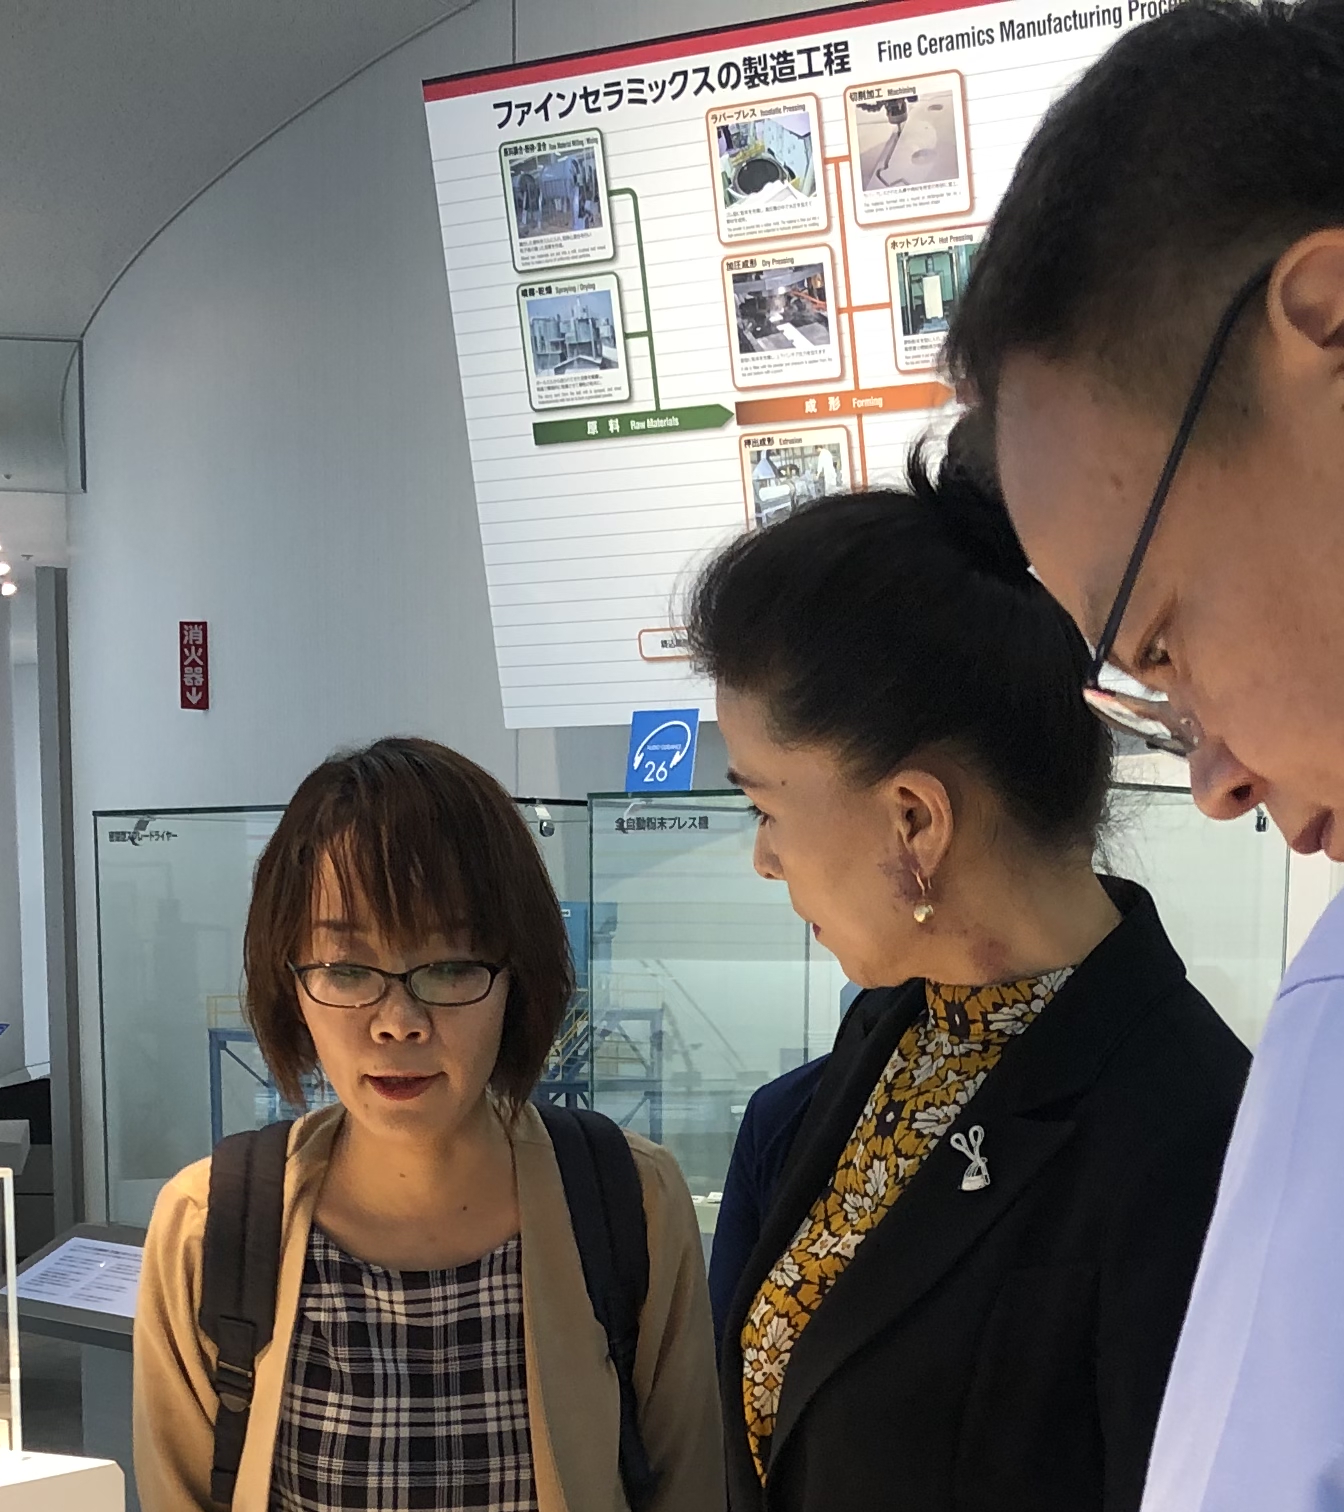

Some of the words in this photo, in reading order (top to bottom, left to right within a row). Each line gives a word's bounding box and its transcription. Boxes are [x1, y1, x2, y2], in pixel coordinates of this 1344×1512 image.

[877, 41, 913, 62] Fine
[917, 26, 995, 56] Ceramics
[999, 5, 1123, 43] Manufacturing
[492, 40, 852, 130] ファインセラミックスの製造工程
[887, 86, 916, 97] Machining
[711, 108, 757, 124] ラバープレス
[890, 235, 936, 250] ホットプレス
[852, 396, 883, 408] Forming
[630, 420, 646, 430] Raw
[646, 416, 680, 429] Materials
[182, 624, 205, 686] 消火器
[643, 761, 668, 783] 26
